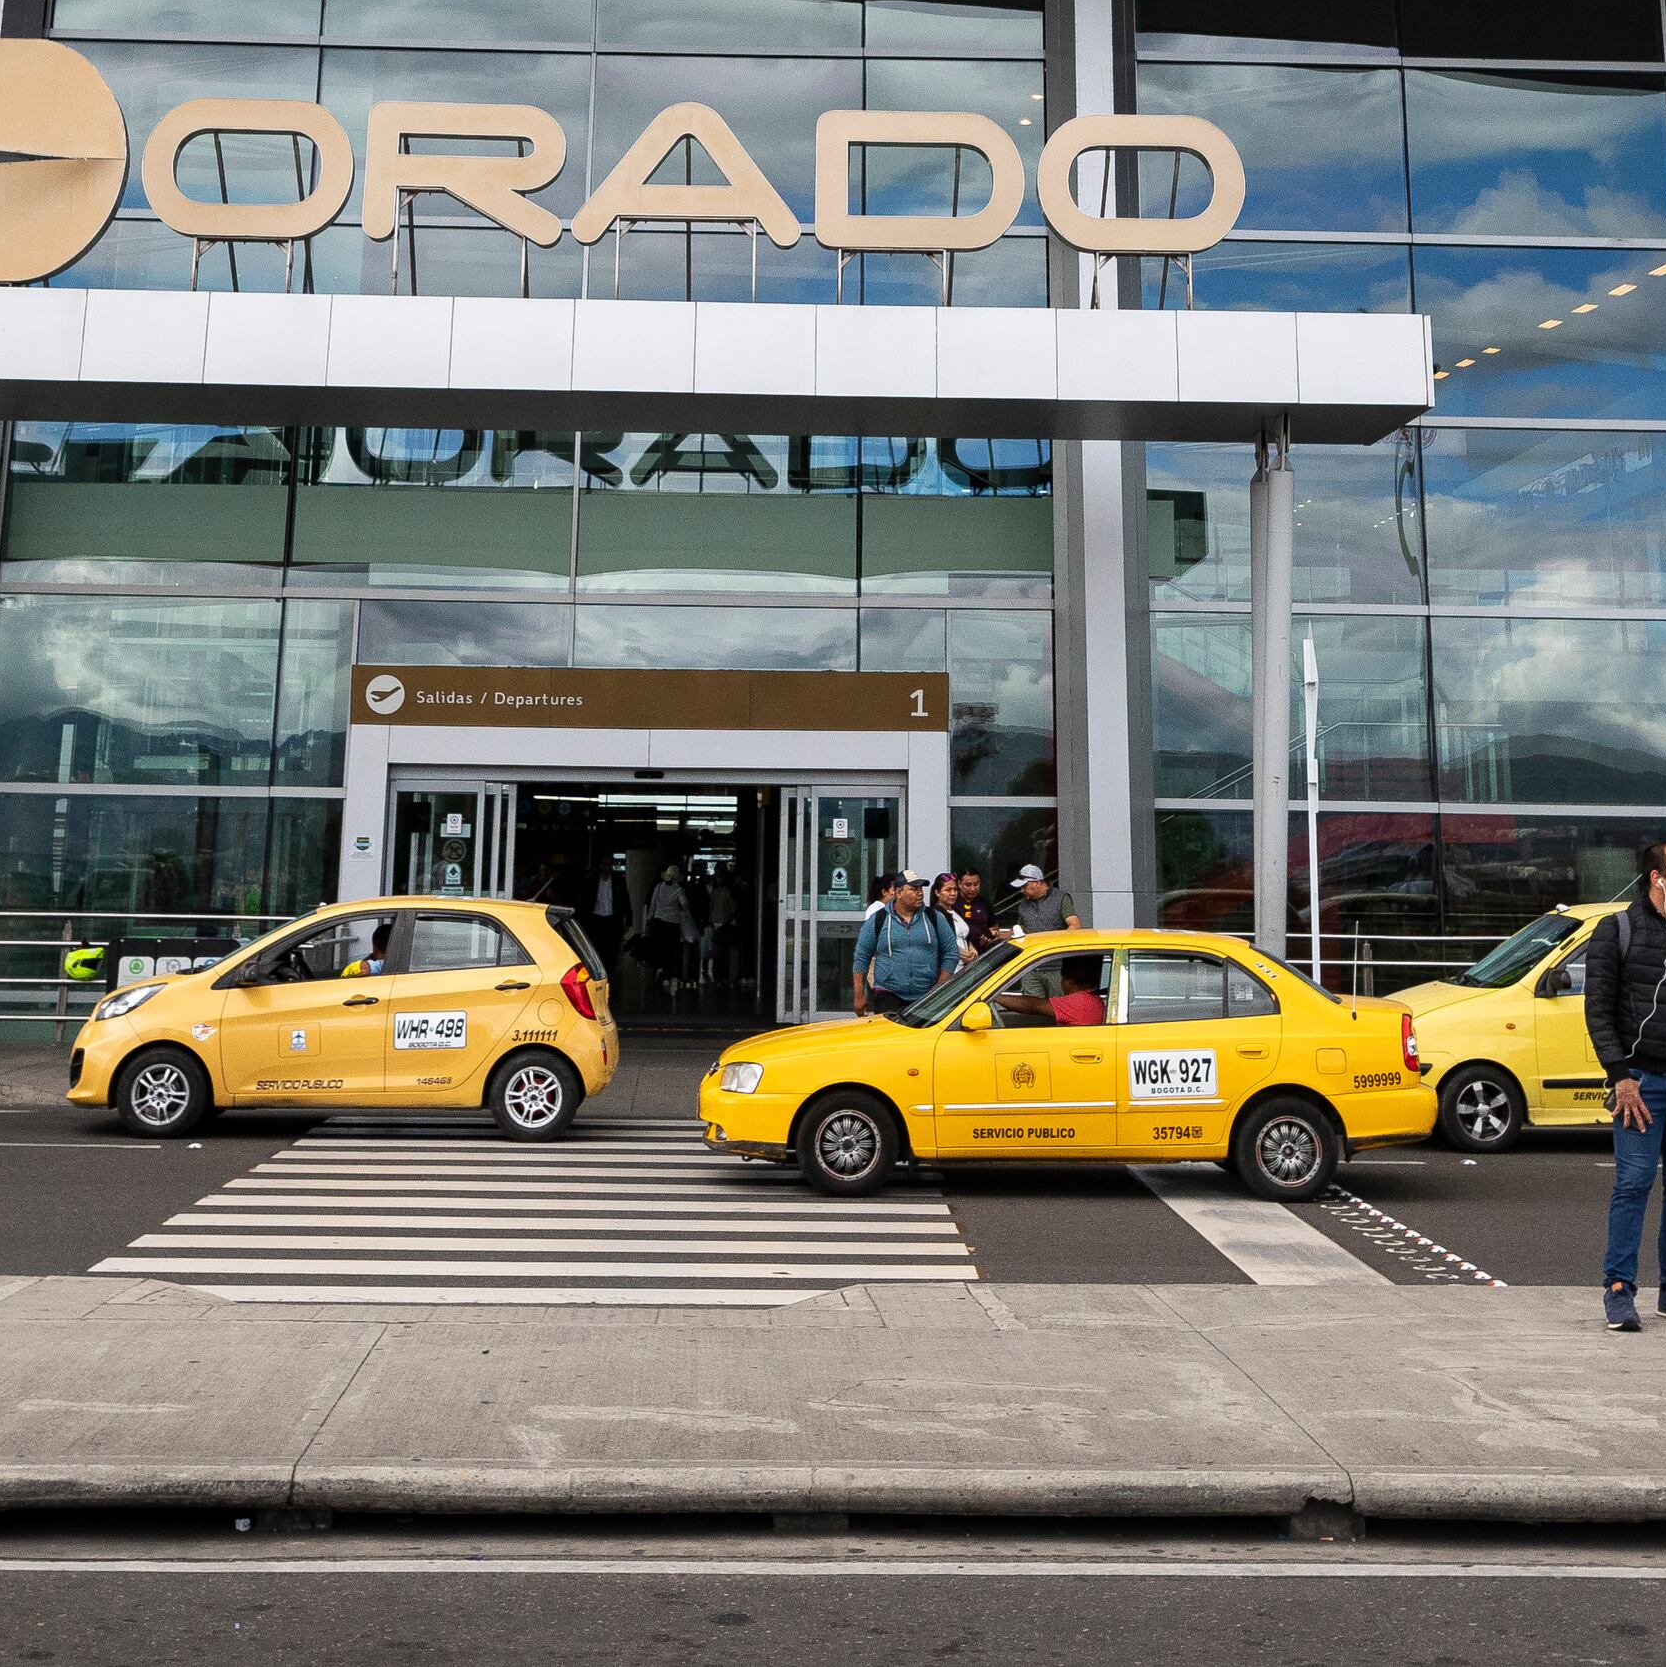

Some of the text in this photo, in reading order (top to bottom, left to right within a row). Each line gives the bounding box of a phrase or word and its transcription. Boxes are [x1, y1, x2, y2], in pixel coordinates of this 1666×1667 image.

[415, 689, 474, 706] Salidas
[493, 690, 584, 709] Departures
[909, 688, 930, 718] 1
[1133, 1058, 1212, 1085] WGK 927
[256, 1079, 344, 1091] SERVICIO PUBLICO
[1353, 1071, 1402, 1089] 5999999
[1151, 1087, 1185, 1095] BOGOTA
[1573, 1091, 1608, 1101] SERVIC
[972, 1127, 1076, 1140] SERVICIO PUBLICO
[1152, 1126, 1191, 1141] 35794
